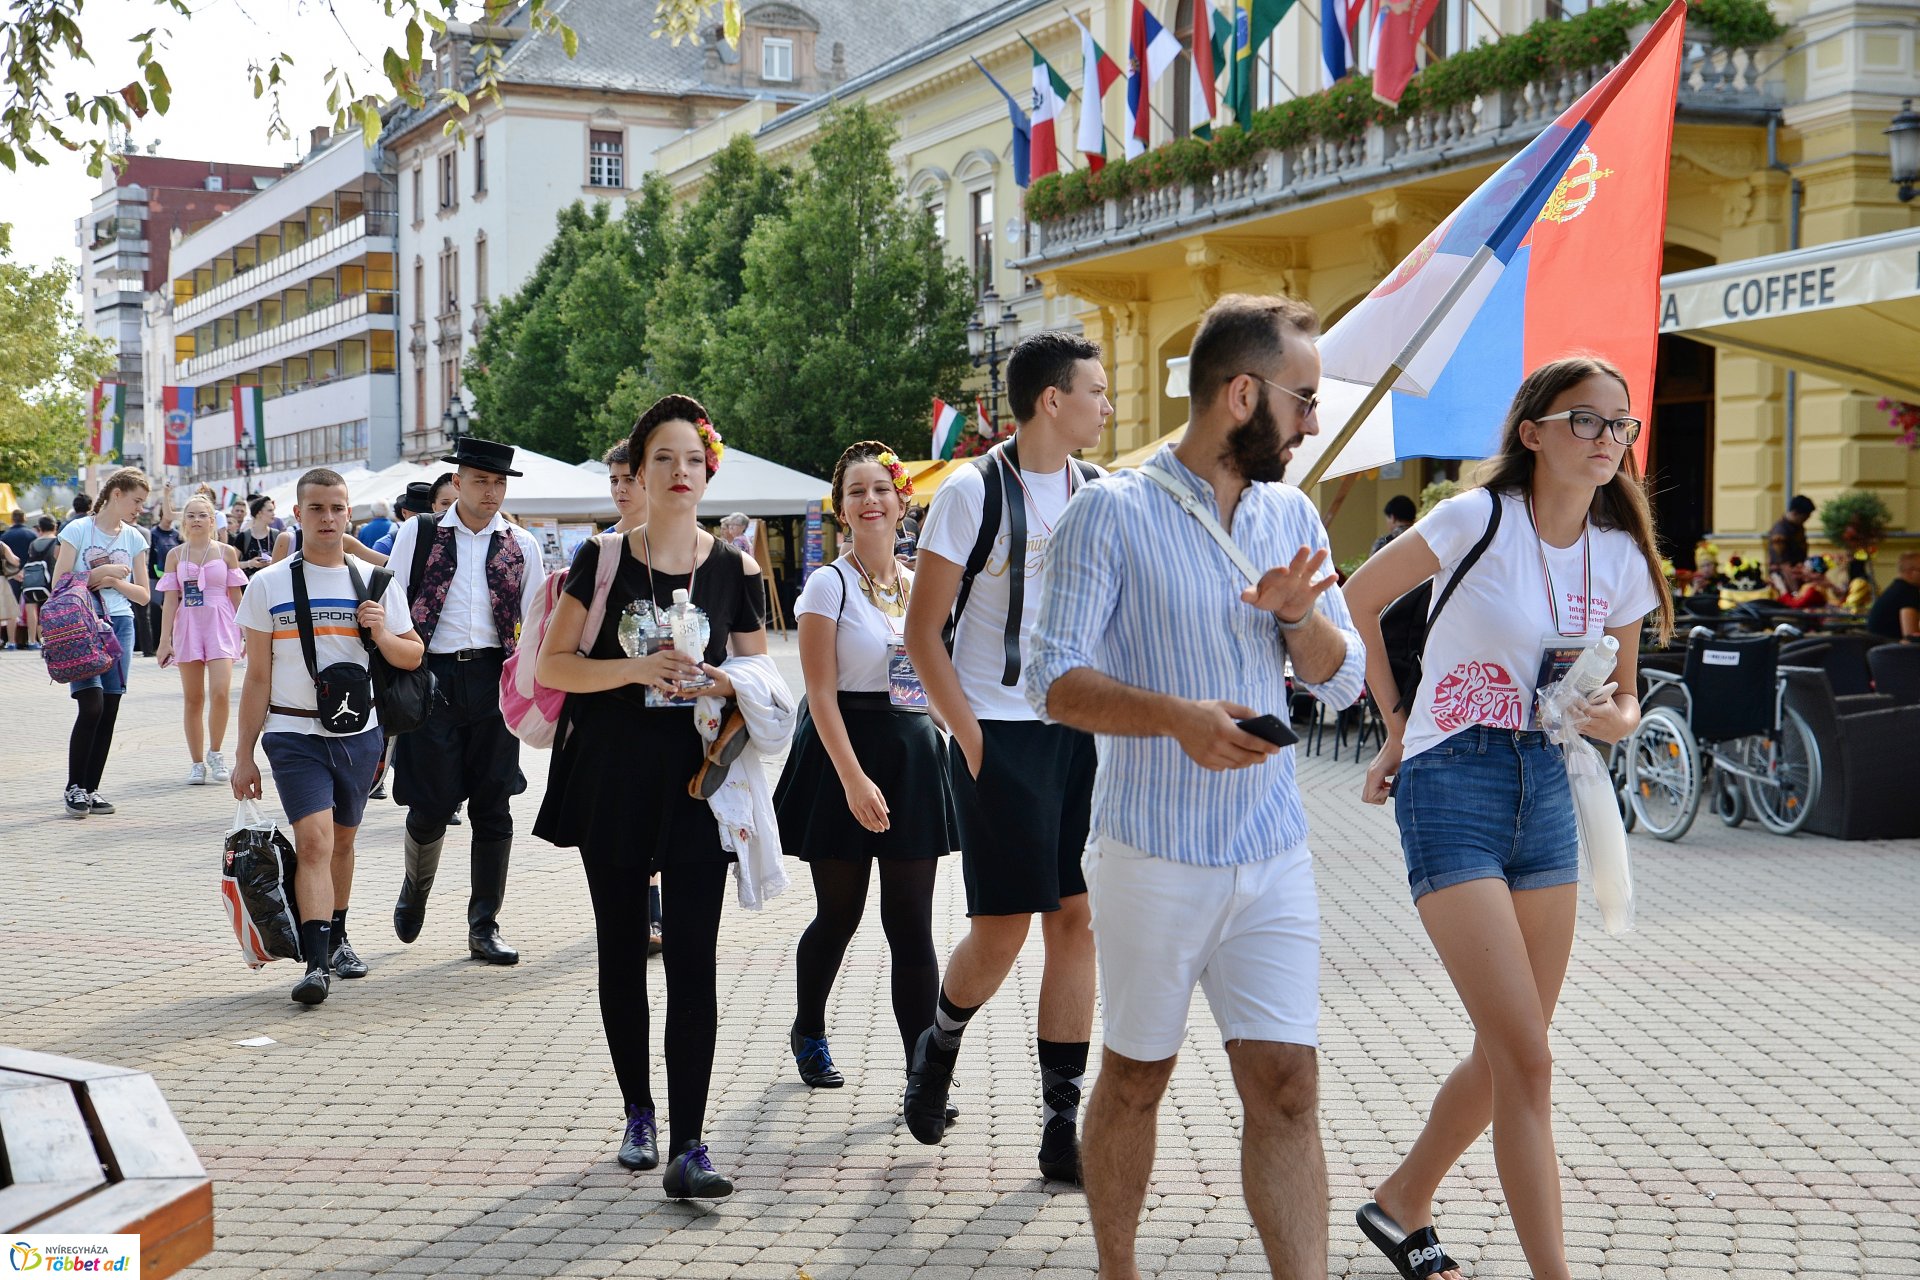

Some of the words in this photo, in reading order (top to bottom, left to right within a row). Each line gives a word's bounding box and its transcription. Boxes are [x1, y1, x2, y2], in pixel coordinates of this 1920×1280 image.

[1661, 293, 1680, 328] A
[1723, 266, 1836, 319] COFFEE
[279, 611, 358, 625] SUERDR
[333, 717, 359, 726] AIR
